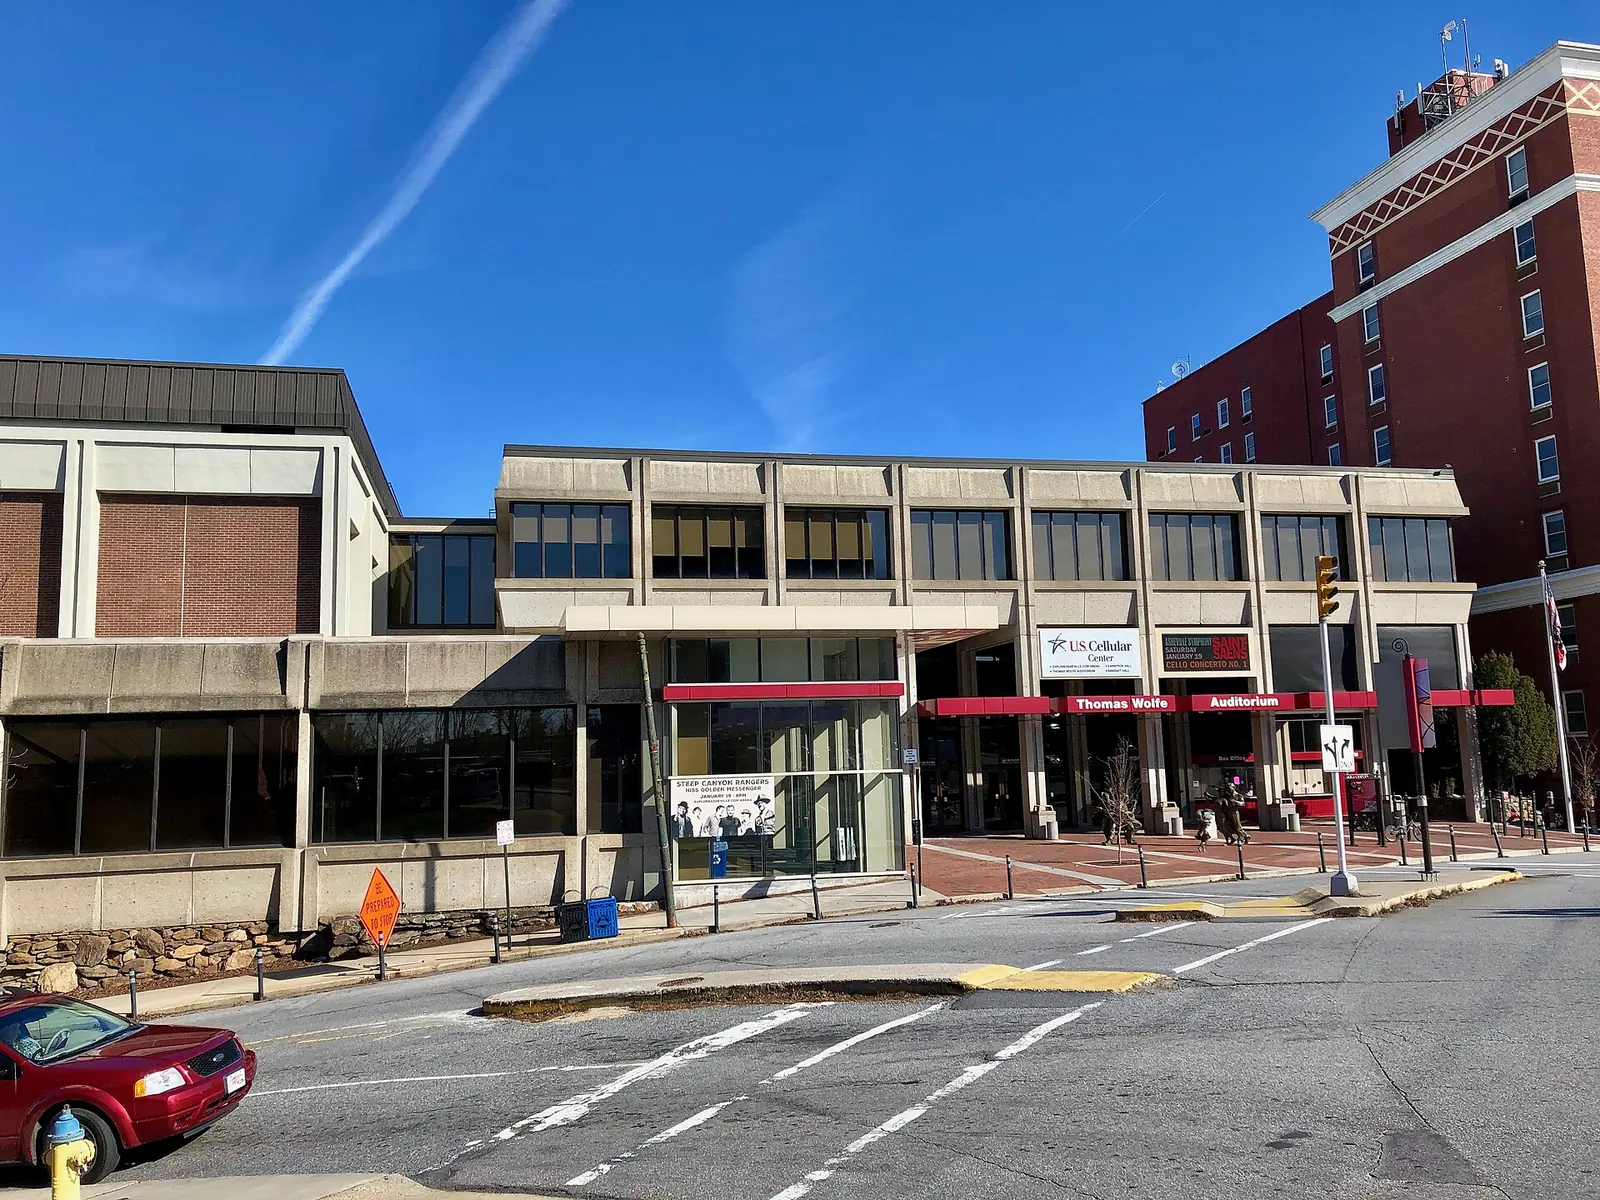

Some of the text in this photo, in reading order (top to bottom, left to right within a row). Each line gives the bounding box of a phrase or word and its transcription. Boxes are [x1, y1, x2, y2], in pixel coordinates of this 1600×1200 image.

[1070, 640, 1132, 652] U.S. Cellular
[1165, 637, 1212, 647] ASHEVILLE SYMPHONY
[1087, 653, 1114, 662] Center
[1166, 661, 1188, 669] CELLO
[1228, 660, 1241, 668] NO.
[1076, 696, 1279, 709] Thomas Wolfe Auditorium
[375, 882, 382, 894] BE
[366, 897, 394, 914] PREPARED
[371, 913, 392, 930] TO STOP
